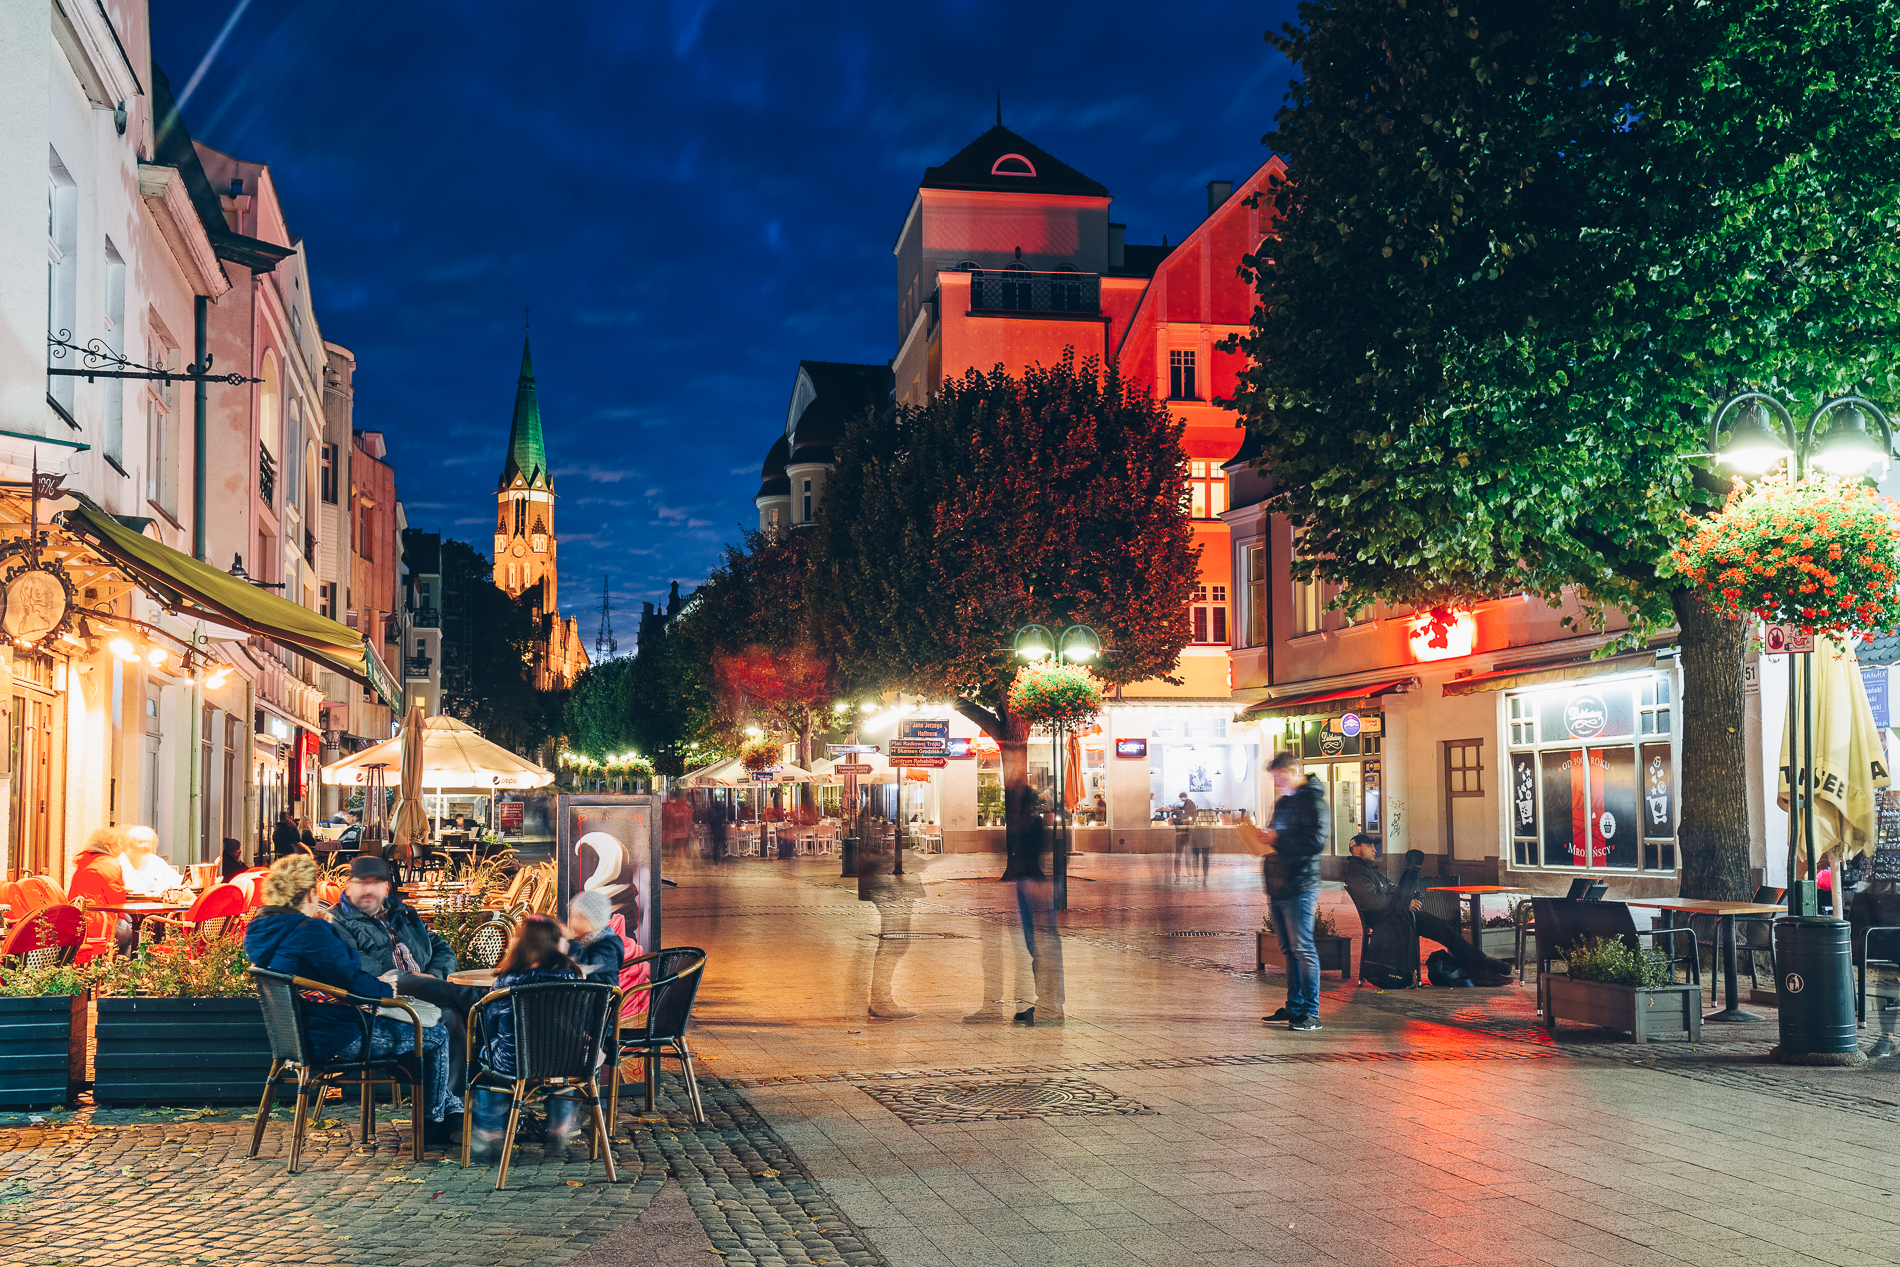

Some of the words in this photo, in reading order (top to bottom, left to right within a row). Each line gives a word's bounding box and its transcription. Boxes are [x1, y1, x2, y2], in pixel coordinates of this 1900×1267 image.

[38, 477, 56, 496] 1996
[1745, 666, 1755, 680] 51
[924, 722, 943, 730] Jerzego
[1562, 760, 1572, 770] OD
[1590, 757, 1610, 770] ROKU
